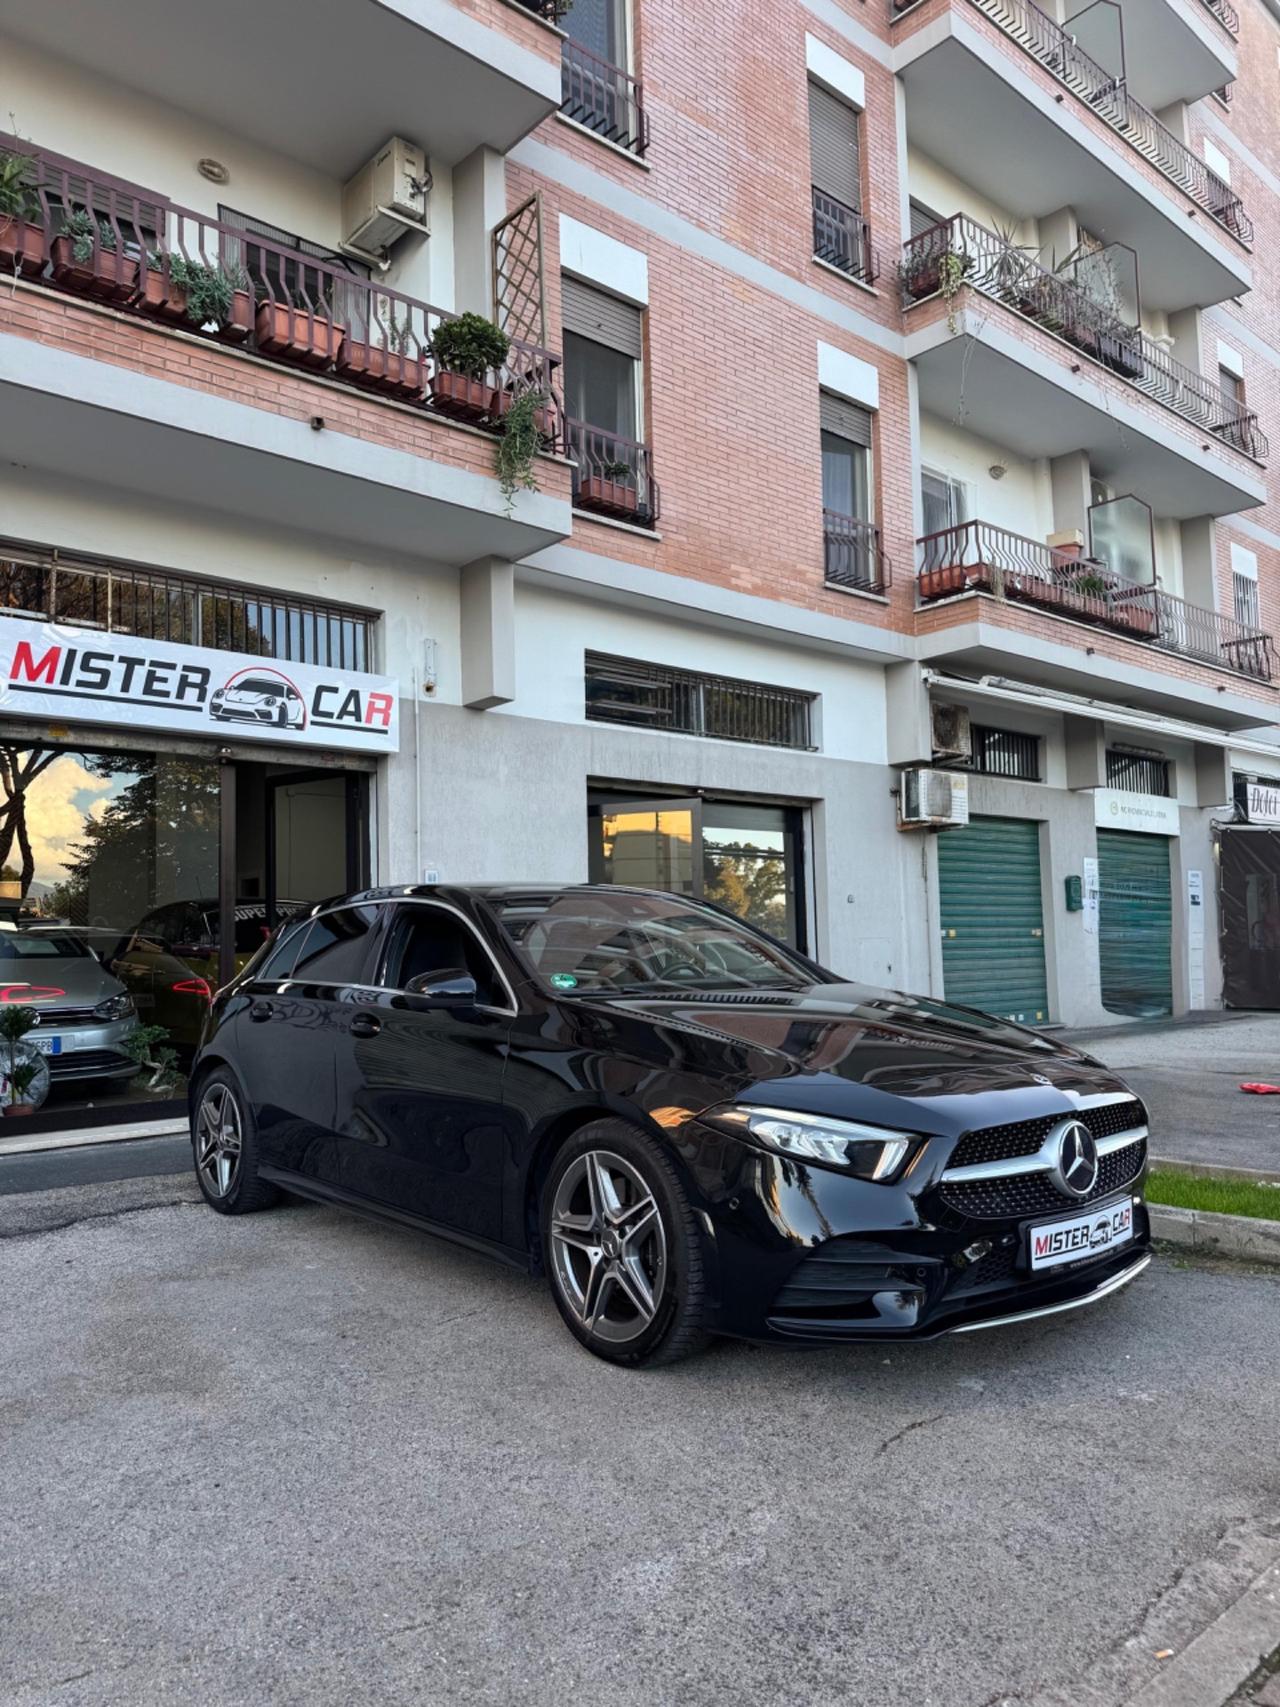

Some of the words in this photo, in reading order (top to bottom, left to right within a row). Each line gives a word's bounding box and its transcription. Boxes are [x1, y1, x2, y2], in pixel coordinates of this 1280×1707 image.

[9, 641, 211, 703] MISTER
[311, 684, 394, 726] CAR
[1035, 1225, 1090, 1256] MISTER
[1113, 1208, 1131, 1232] CAR
